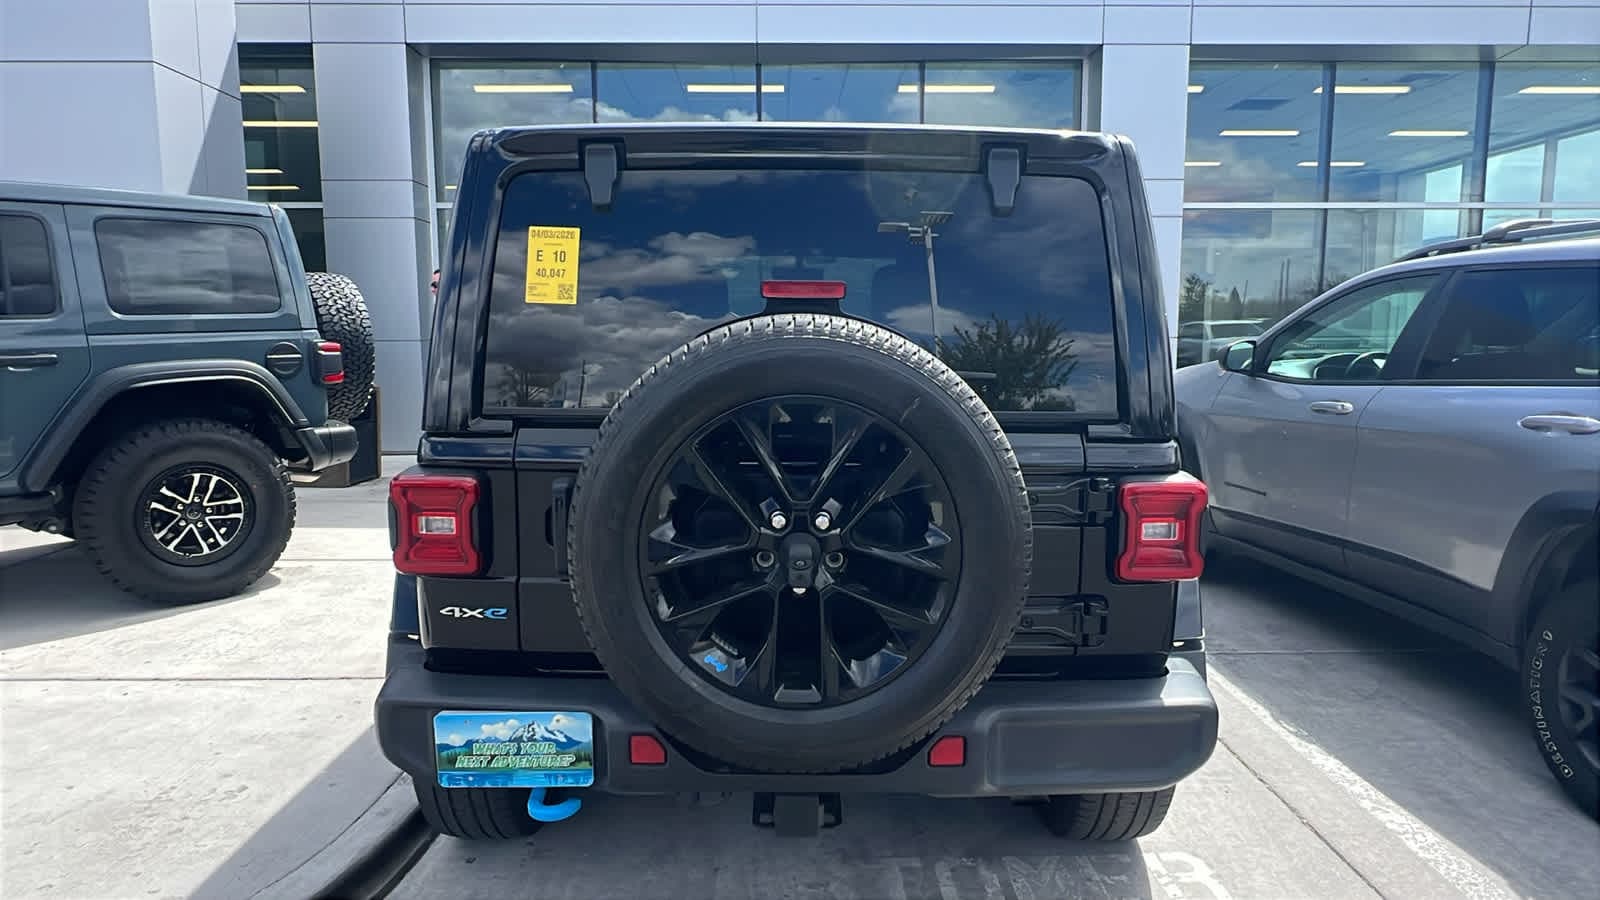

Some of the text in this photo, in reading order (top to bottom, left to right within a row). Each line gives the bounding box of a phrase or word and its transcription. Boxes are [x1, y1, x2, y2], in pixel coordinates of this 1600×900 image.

[536, 250, 566, 263] E 10
[535, 268, 566, 279] 40,047
[1529, 642, 1574, 778] DESTINATION
[472, 742, 556, 755] WHAT'S YOUR
[455, 755, 576, 769] NEXT ADVENTURE?
